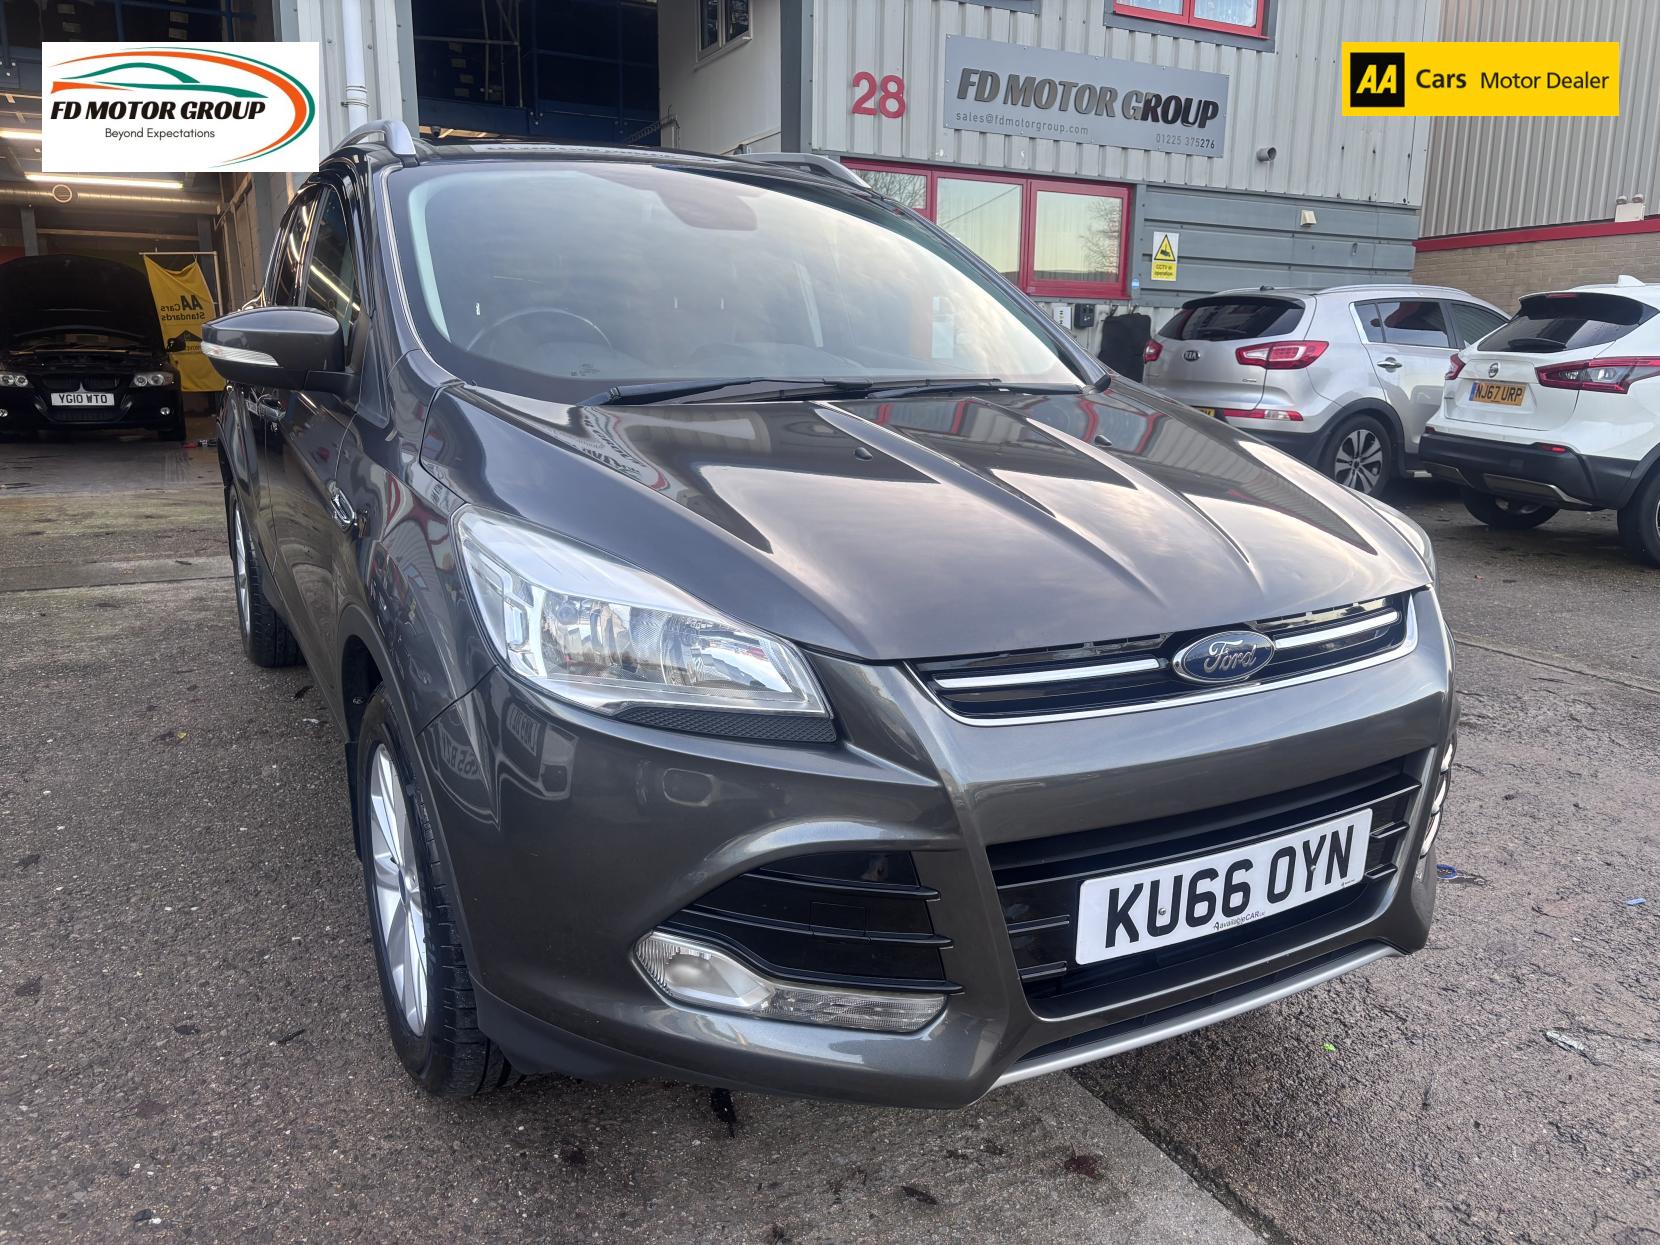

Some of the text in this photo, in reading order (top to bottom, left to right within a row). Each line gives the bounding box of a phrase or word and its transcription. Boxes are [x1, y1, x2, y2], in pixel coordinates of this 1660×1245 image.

[851, 71, 906, 119] 28
[956, 67, 1220, 129] FD MOTOR GROUP
[955, 111, 1089, 136] sales@fdmotorgroup.com
[1155, 133, 1215, 149] 01225 375276
[1475, 383, 1523, 402] NJ67 URP
[1203, 639, 1257, 673] Ford
[1105, 824, 1355, 949] KU66 OYN
